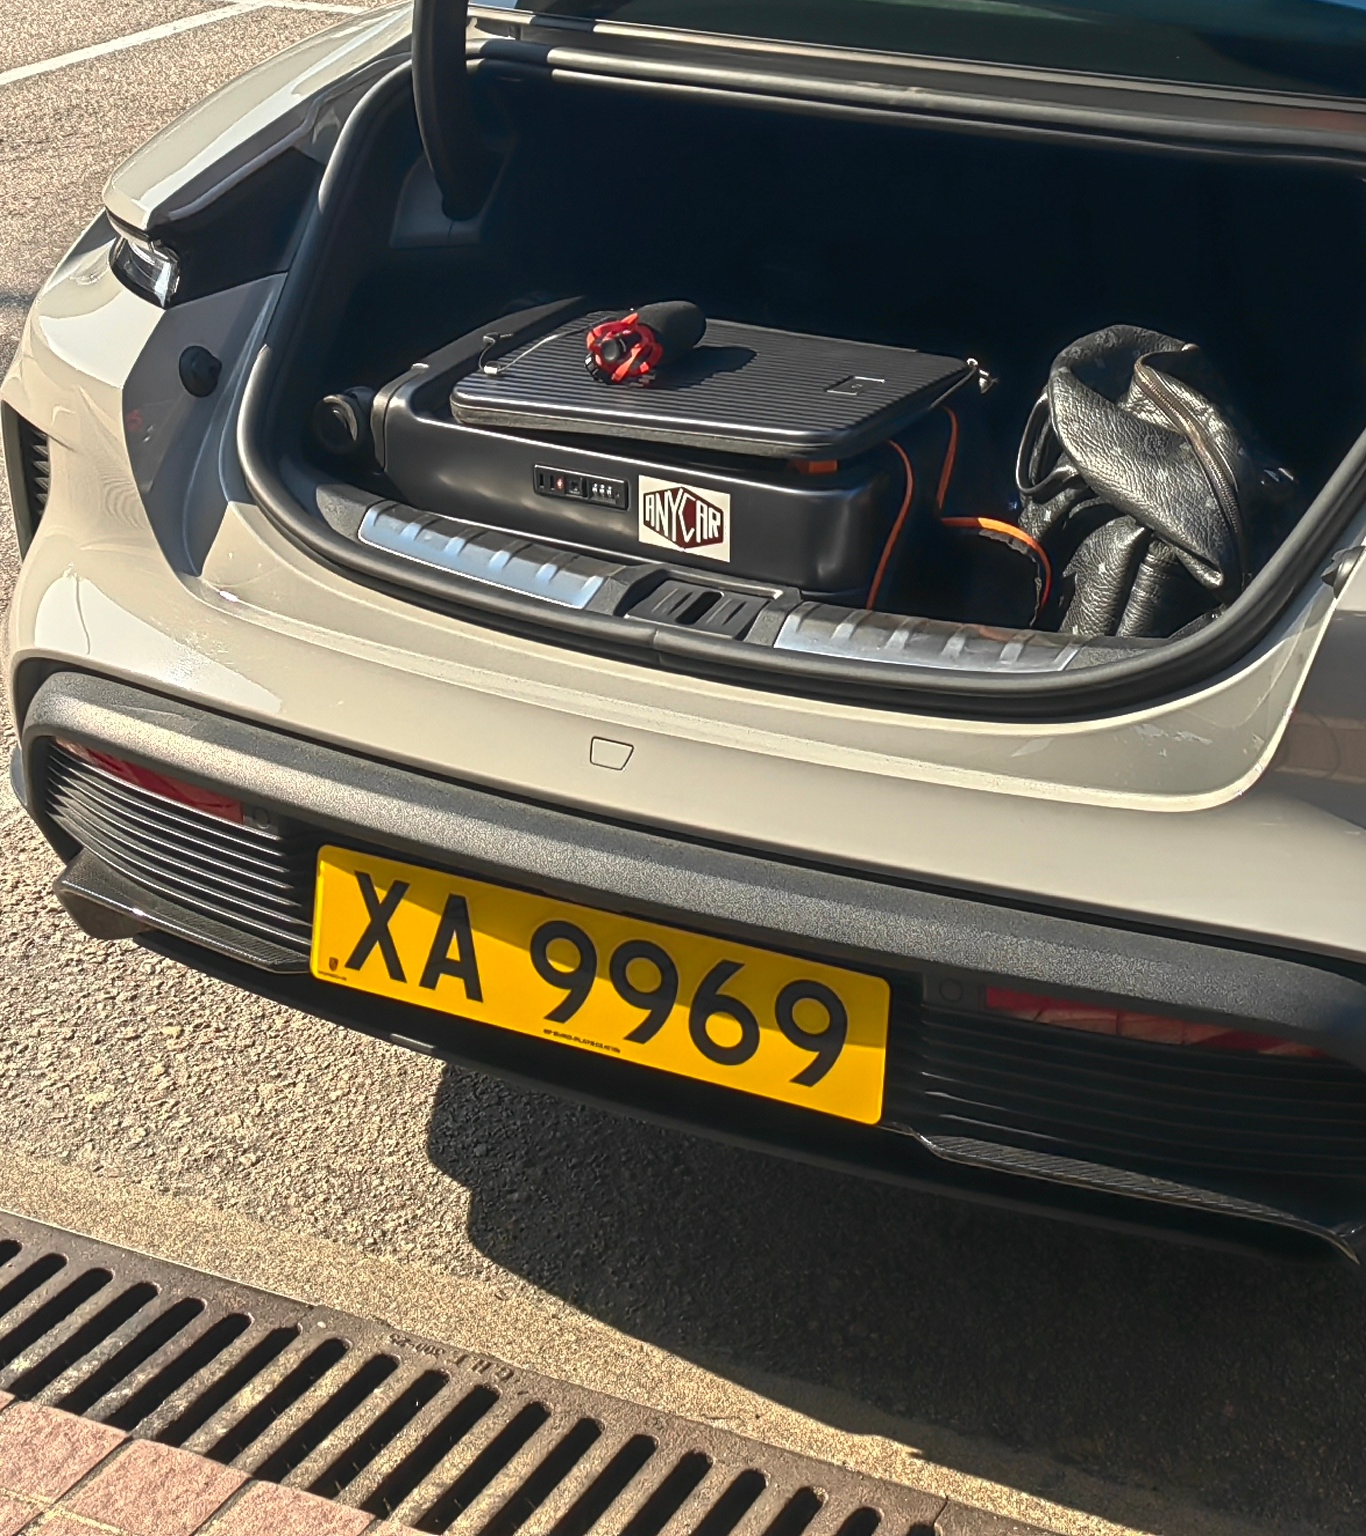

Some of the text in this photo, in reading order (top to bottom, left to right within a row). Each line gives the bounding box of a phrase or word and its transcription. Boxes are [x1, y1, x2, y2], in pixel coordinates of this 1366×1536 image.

[645, 487, 721, 544] ANYCAR
[344, 870, 849, 1088] XA 9969
